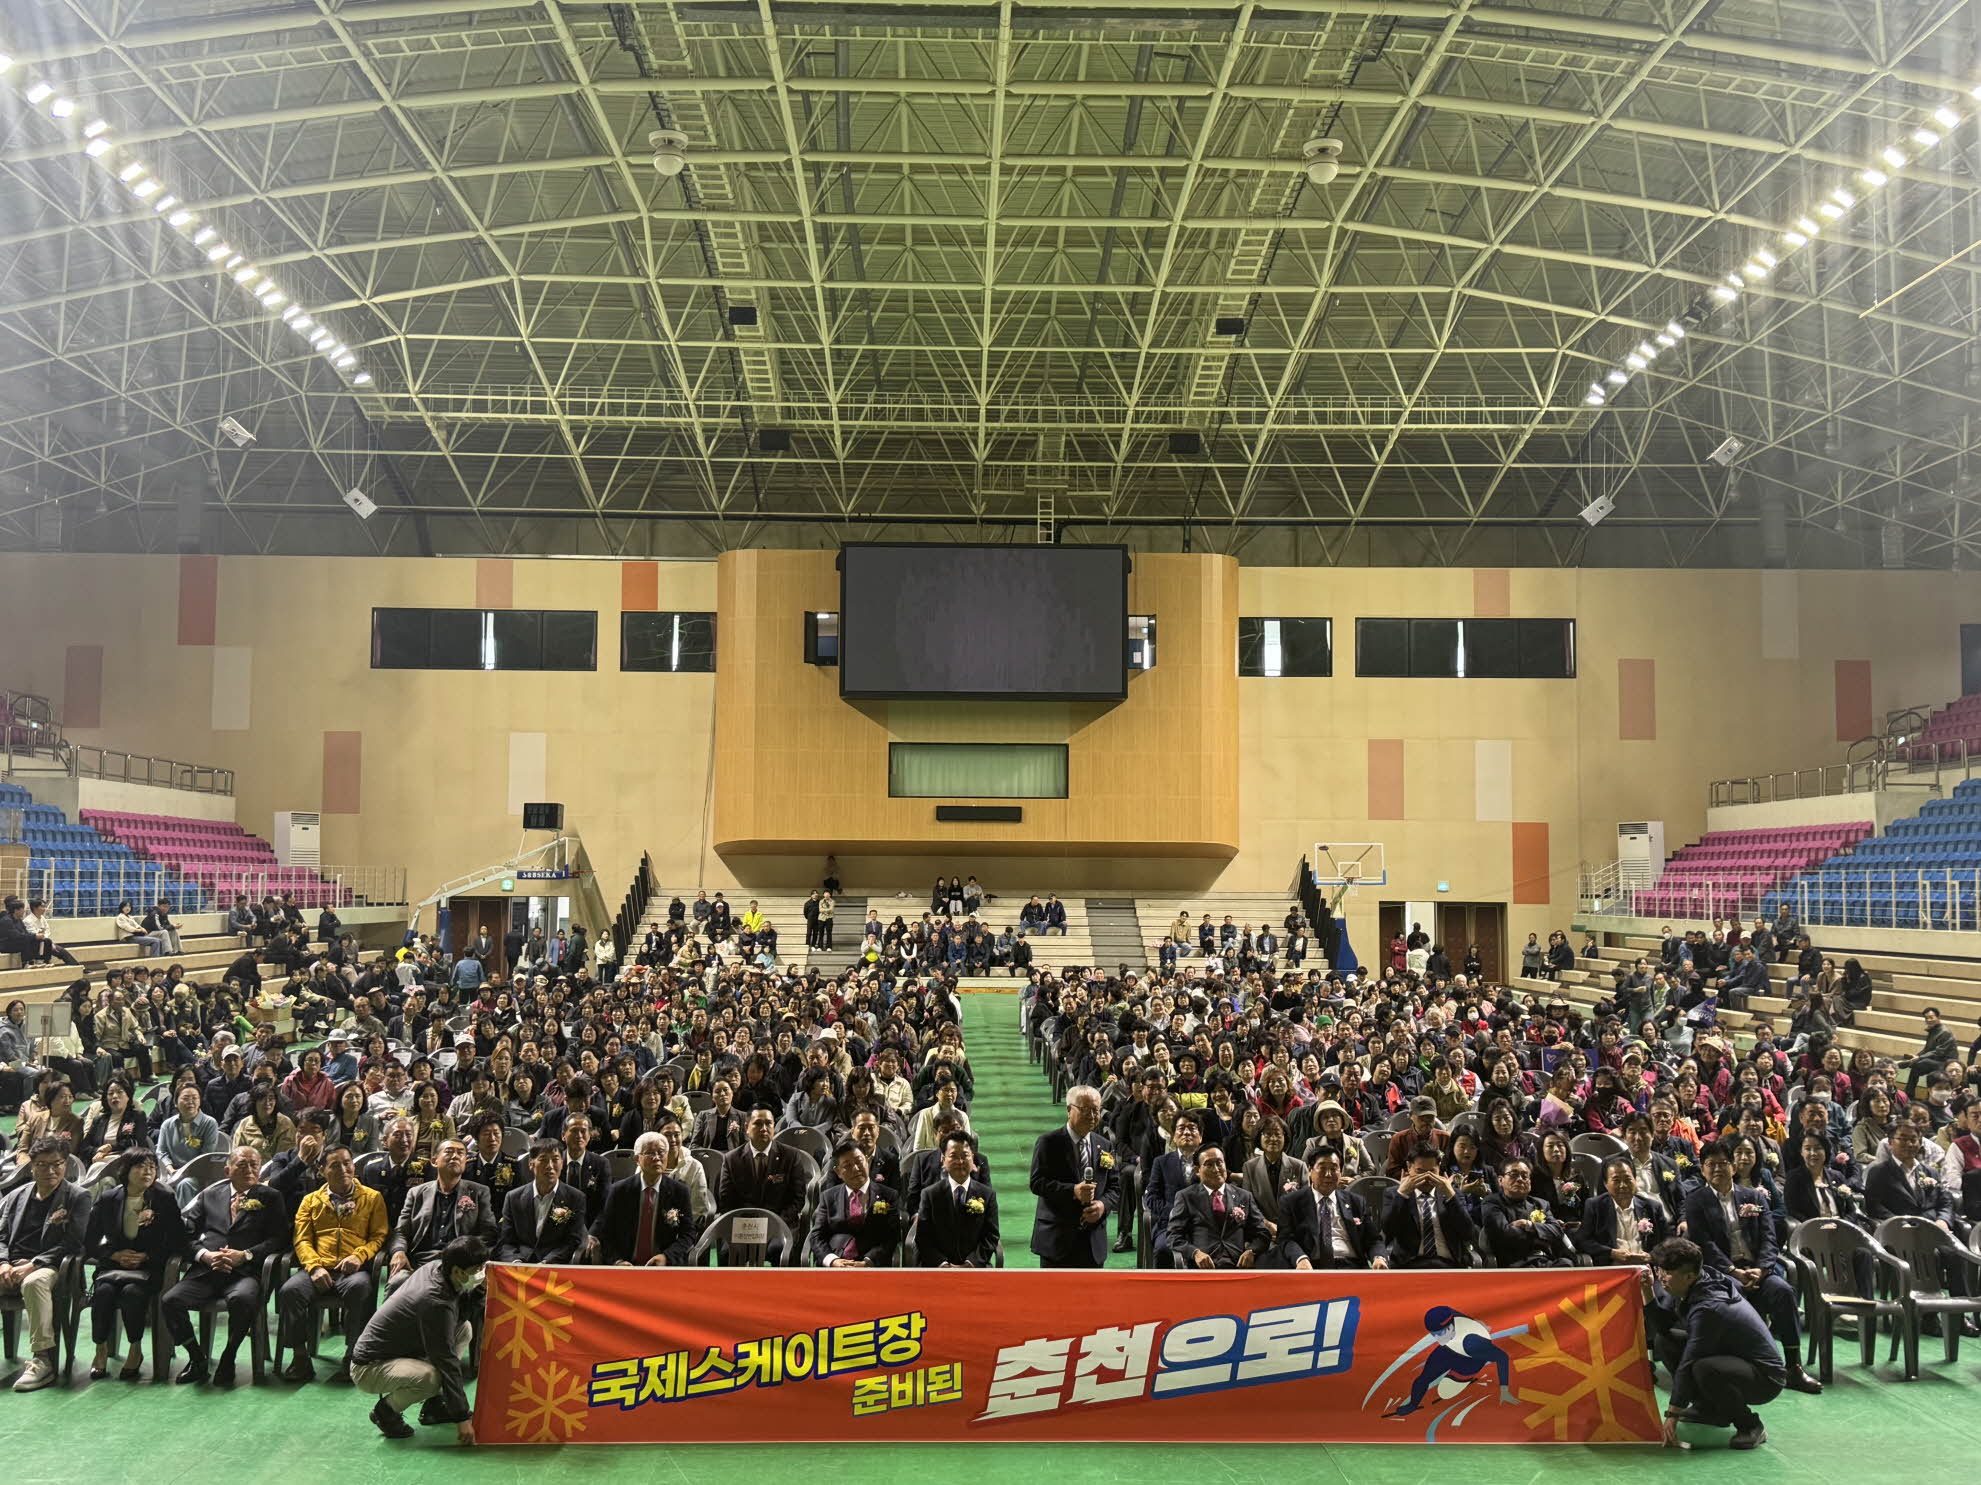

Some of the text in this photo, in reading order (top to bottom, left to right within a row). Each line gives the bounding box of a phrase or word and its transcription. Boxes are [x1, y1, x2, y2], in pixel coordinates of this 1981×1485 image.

[588, 1311, 927, 1410] 국제스케이트장
[852, 1361, 963, 1417] 준비된
[971, 1298, 1352, 1422] 춘천으로!
